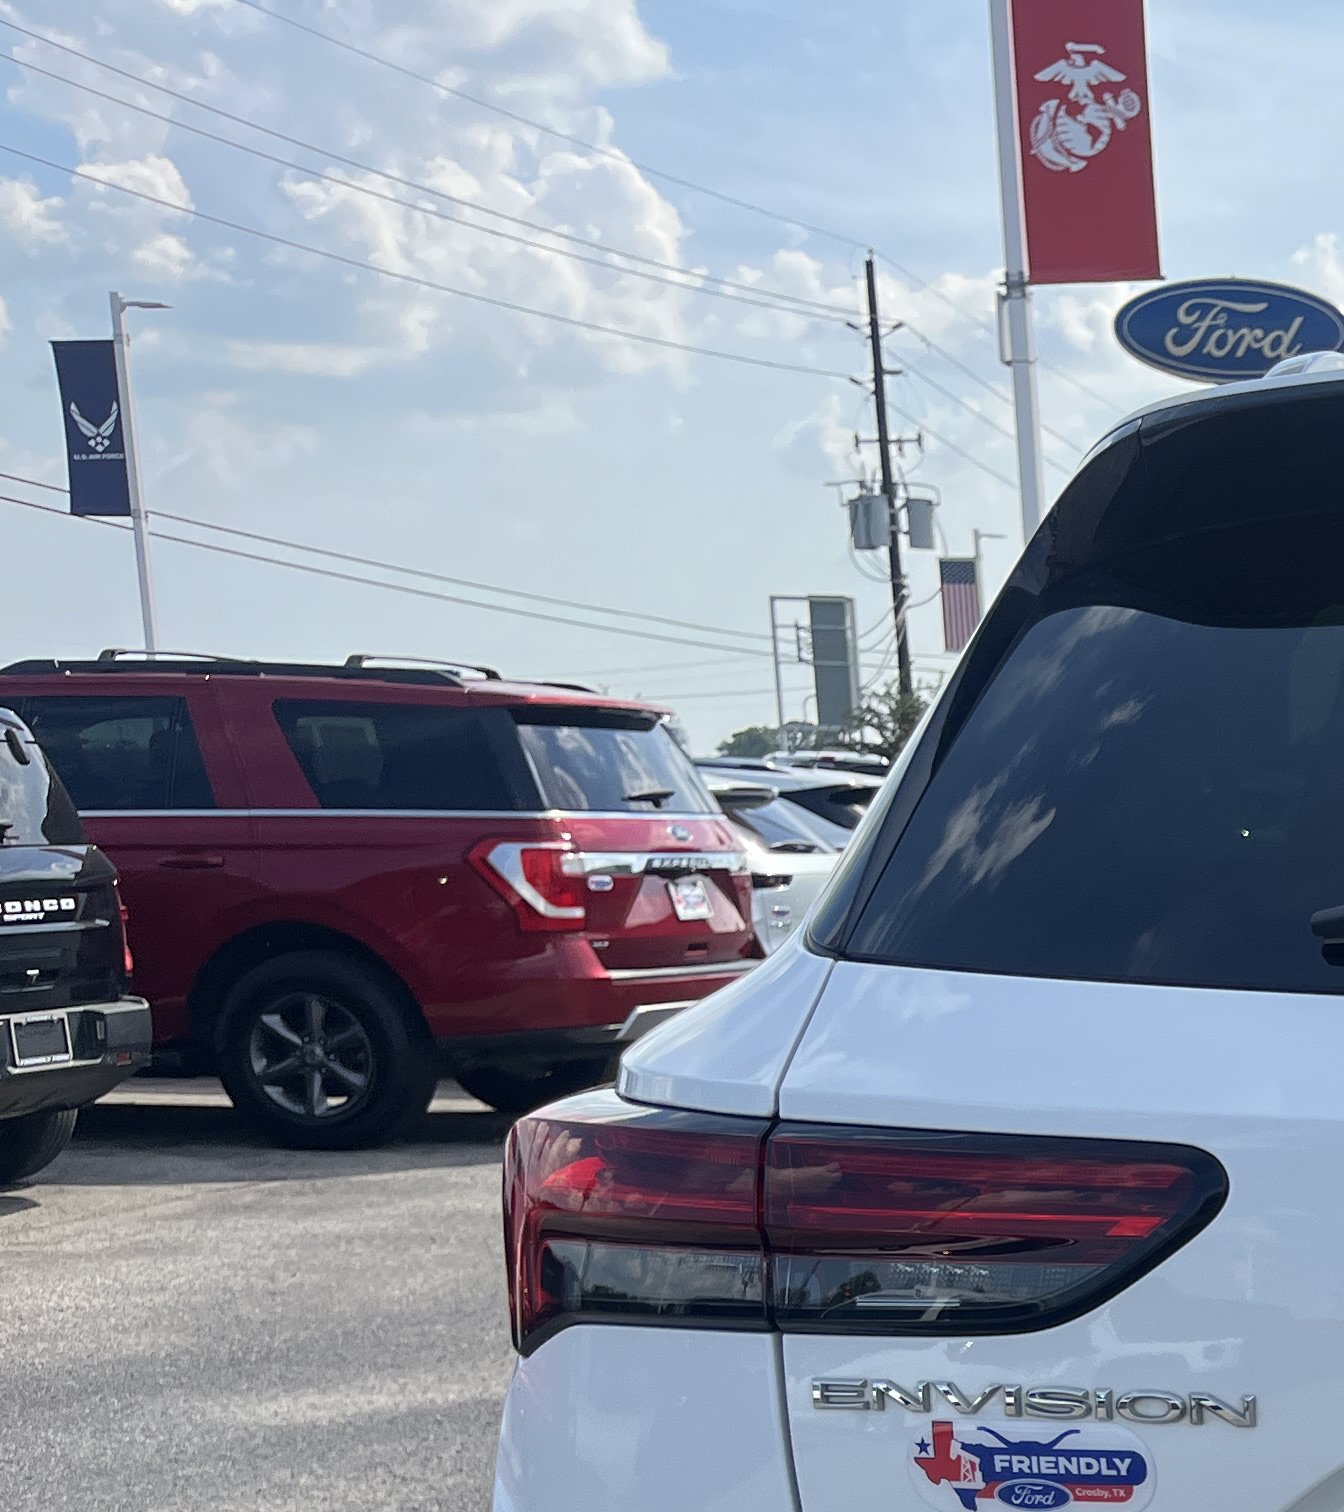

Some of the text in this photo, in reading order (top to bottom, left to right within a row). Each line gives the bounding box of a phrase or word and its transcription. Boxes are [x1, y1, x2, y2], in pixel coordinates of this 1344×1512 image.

[1164, 297, 1304, 359] Ford
[0, 897, 76, 914] ONCO
[811, 1377, 1257, 1428] ENVISION
[992, 1453, 1132, 1477] FRIENDLY
[1010, 1484, 1056, 1506] Ford
[1075, 1487, 1127, 1499] Crosby, TX
